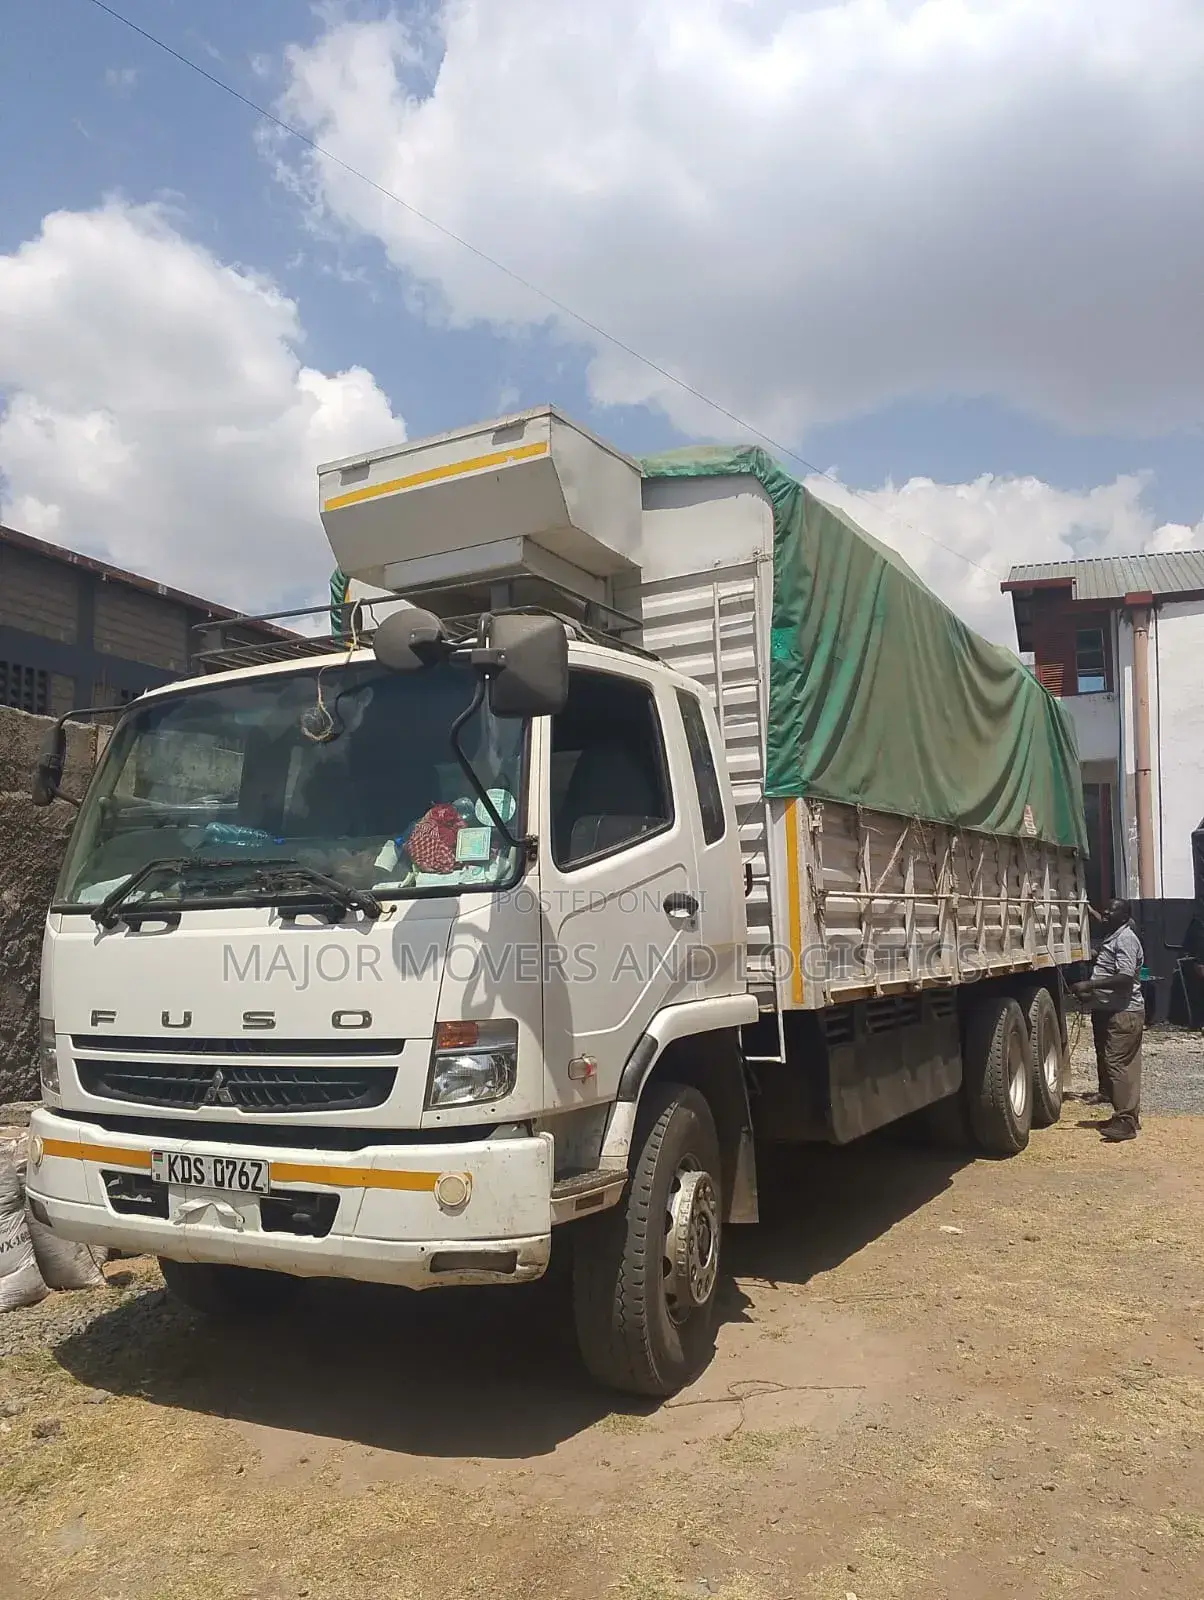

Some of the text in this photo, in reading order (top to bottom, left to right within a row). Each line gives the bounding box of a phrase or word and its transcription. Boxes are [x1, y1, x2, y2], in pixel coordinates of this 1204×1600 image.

[90, 1009, 373, 1031] FUSO
[167, 1154, 264, 1192] KDS 076Z
